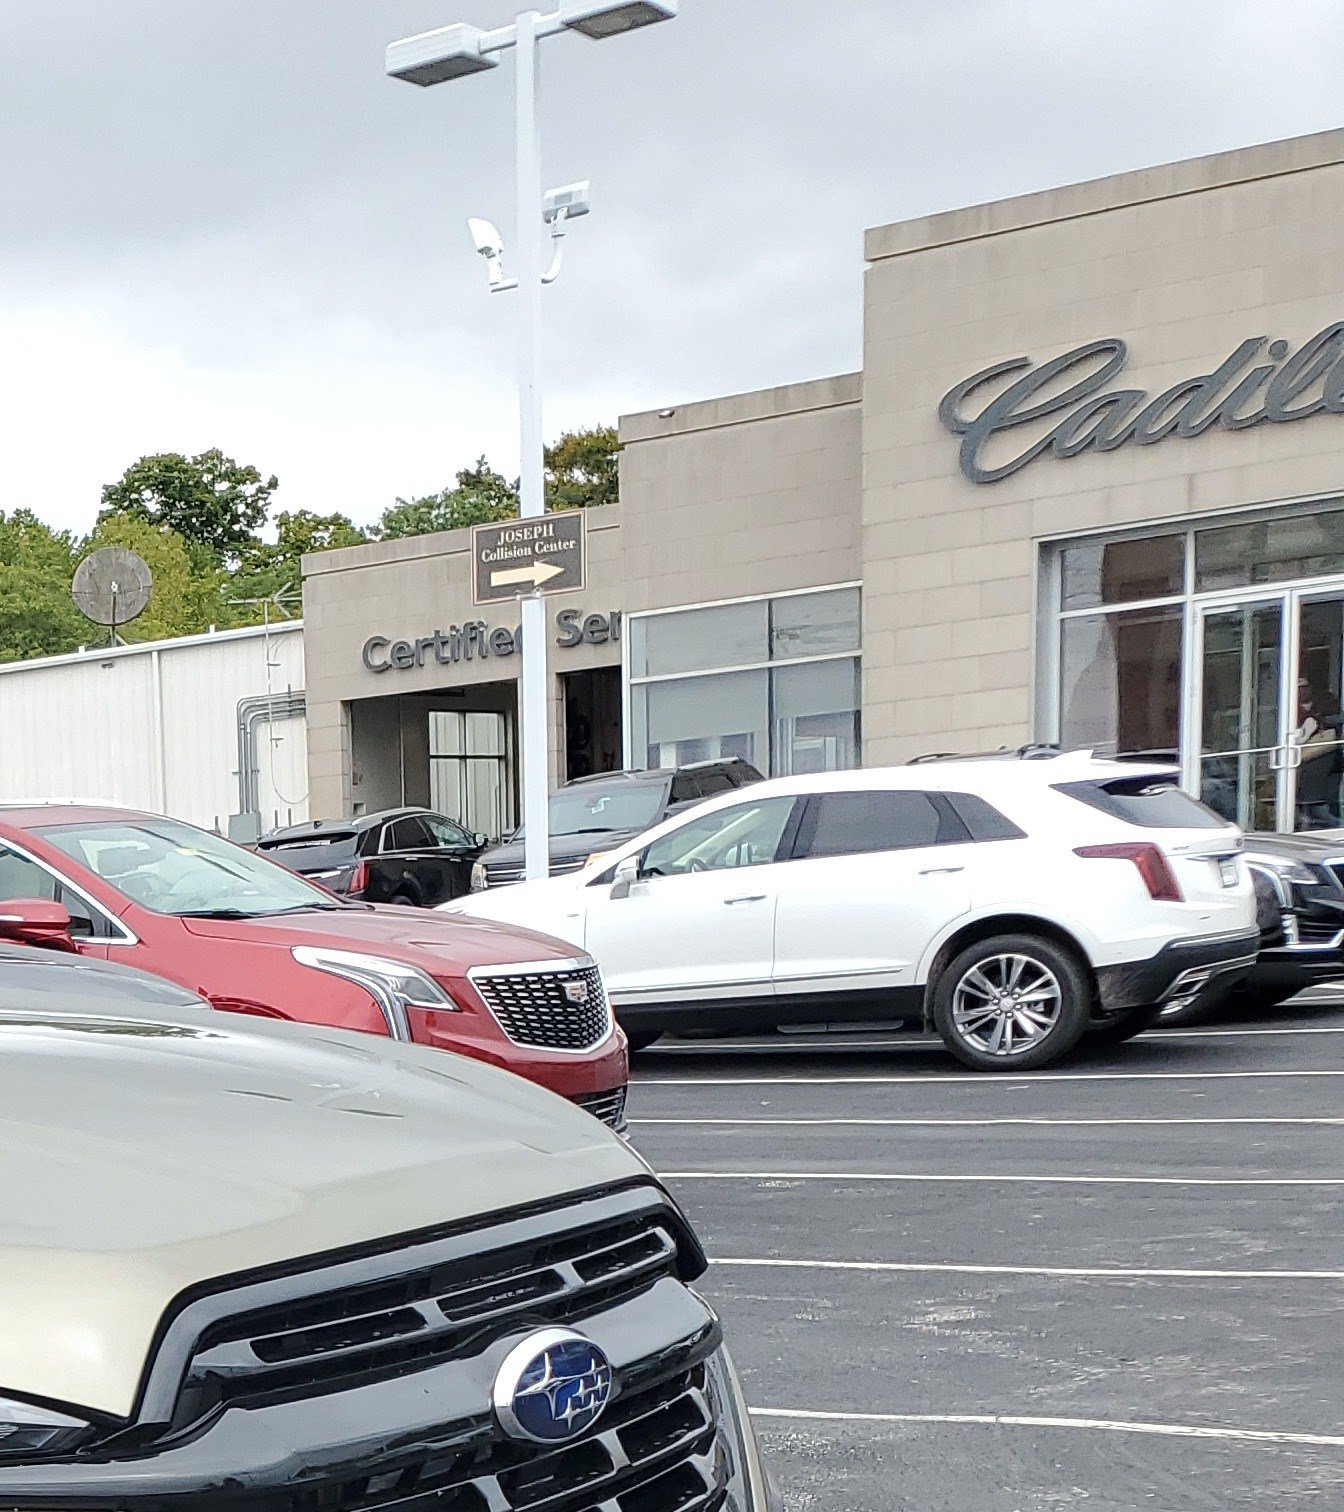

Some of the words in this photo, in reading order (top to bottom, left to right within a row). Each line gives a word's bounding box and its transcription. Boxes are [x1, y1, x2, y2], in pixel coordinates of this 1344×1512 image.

[938, 320, 1344, 485] Cadil
[497, 522, 555, 546] JOSEPH
[481, 545, 533, 563] Collision
[534, 539, 577, 555] Center
